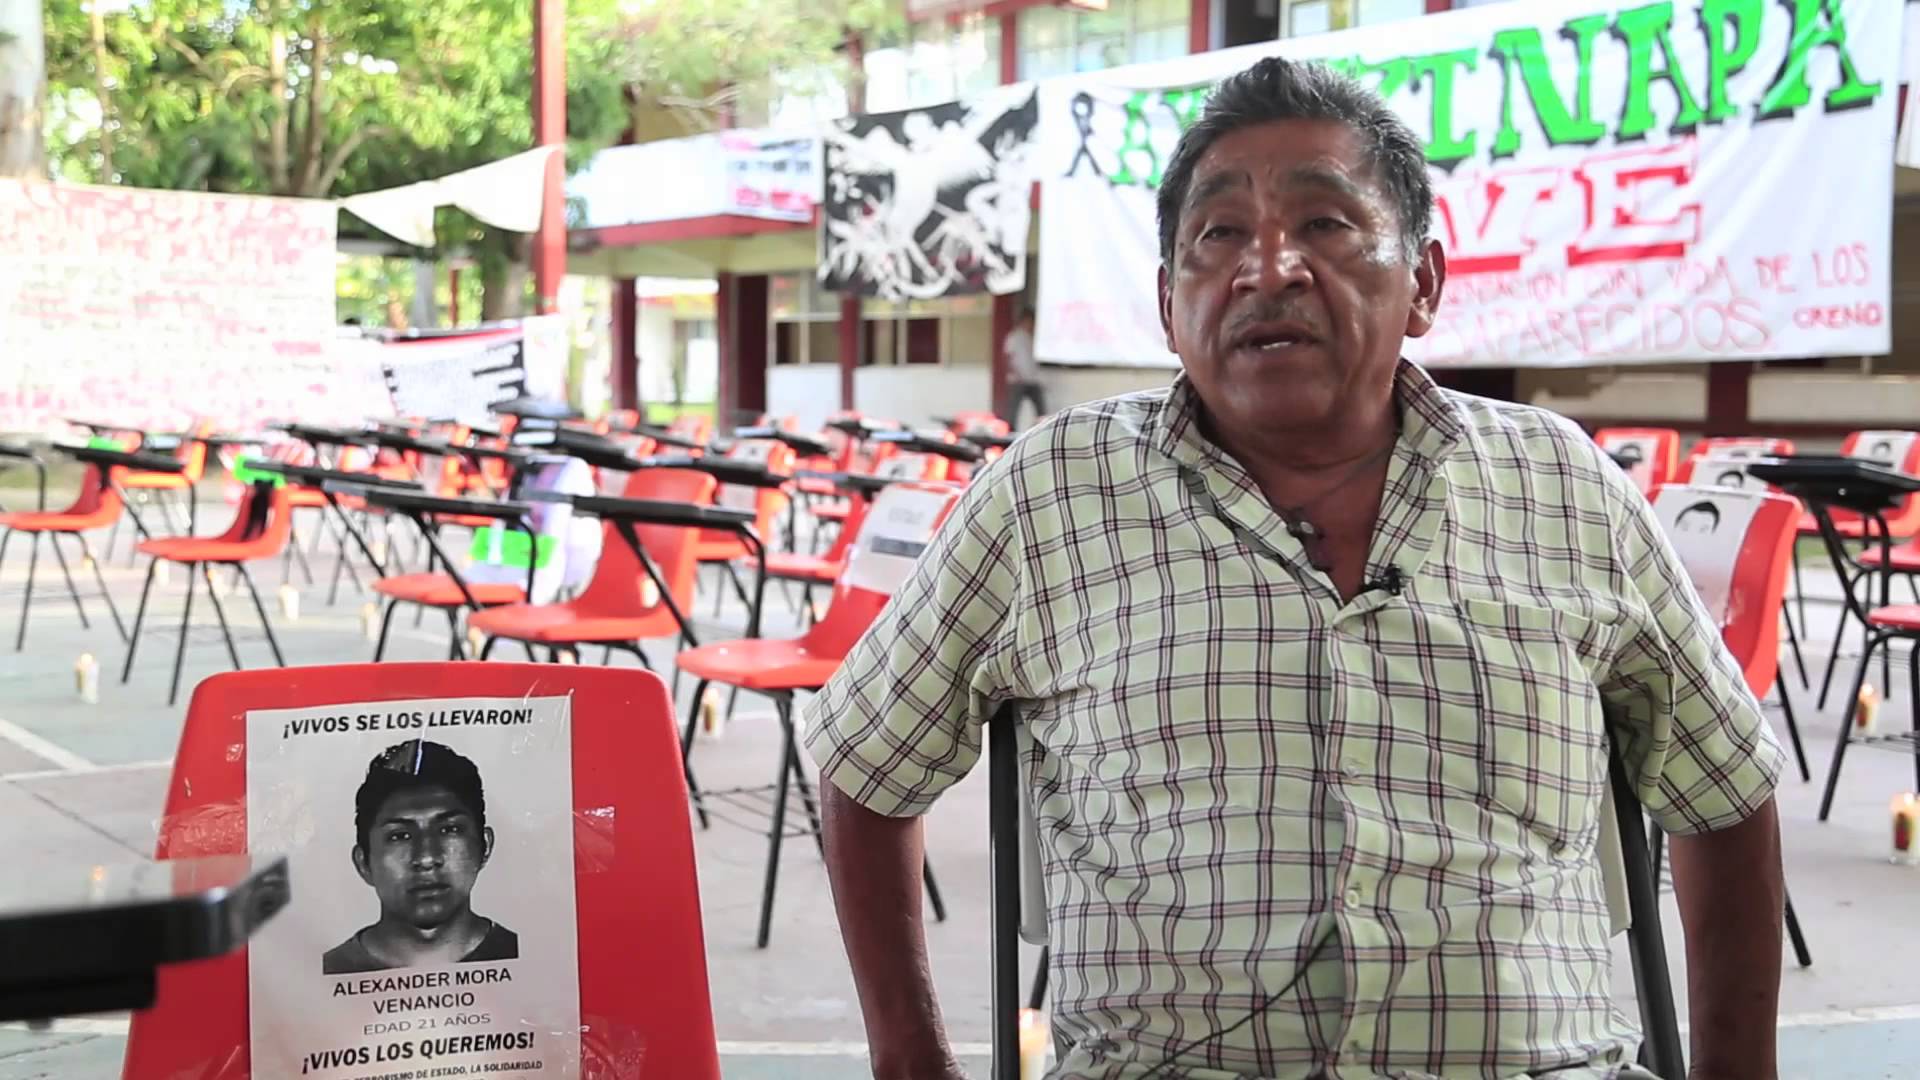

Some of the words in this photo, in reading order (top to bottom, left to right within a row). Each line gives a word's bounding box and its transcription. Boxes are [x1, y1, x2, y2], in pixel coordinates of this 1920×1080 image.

[1754, 253, 1797, 294] DE
[1811, 241, 1872, 288] LOS
[283, 715, 350, 738] ¡VIVOS
[356, 713, 380, 731] SE
[386, 711, 423, 729] LOS
[428, 708, 533, 727] LLEVARON!
[333, 972, 450, 997] ALEXANDER
[455, 967, 512, 986] MORA
[373, 992, 475, 1014] VENANCIO
[363, 1020, 411, 1036] EDAD
[418, 1018, 436, 1030] 21
[444, 1013, 491, 1027] AÑOS
[302, 1046, 370, 1074] ¡VIVOS
[376, 1042, 414, 1063] LOS
[420, 1031, 535, 1059] QUEREMOS!
[416, 1068, 429, 1079] DE
[431, 1065, 468, 1077] ESTADO,
[470, 1063, 481, 1074] LA
[484, 1060, 543, 1073] SOLIDARIDAD
